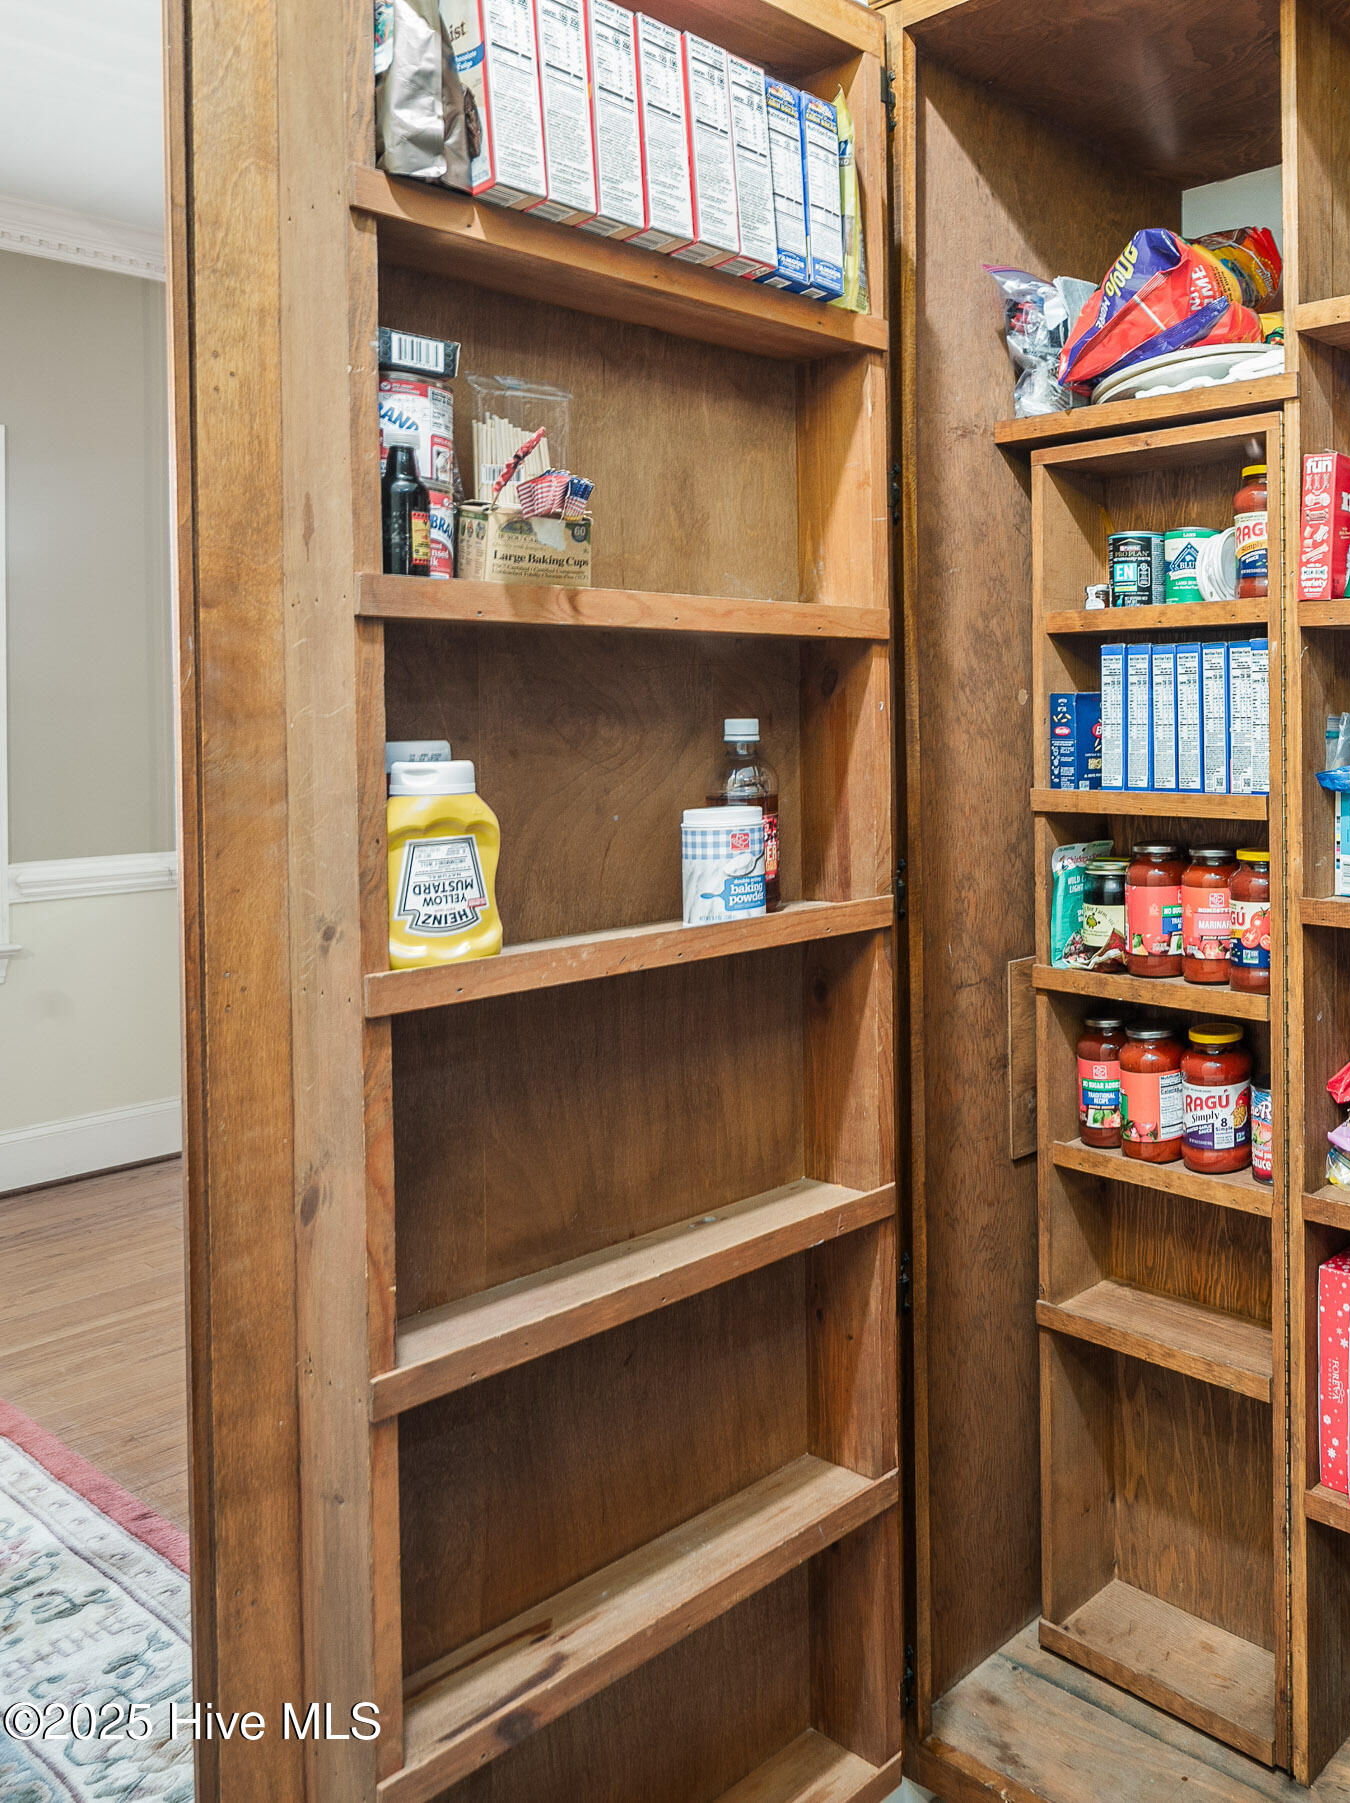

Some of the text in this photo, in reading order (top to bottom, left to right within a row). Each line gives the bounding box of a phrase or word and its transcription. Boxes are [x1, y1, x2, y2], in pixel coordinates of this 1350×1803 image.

[1306, 457, 1332, 474] fun
[1236, 522, 1267, 546] RAG
[493, 550, 526, 564] Large
[527, 552, 565, 567] Baking
[566, 555, 589, 569] Cups
[1180, 561, 1195, 569] BLU
[1116, 565, 1133, 580] EN
[413, 878, 474, 895] MUSTARD
[730, 882, 763, 895] baking
[423, 892, 467, 907] YELLOW
[729, 891, 764, 909] powder
[421, 908, 469, 926] HEINZ
[1231, 906, 1245, 926] GÚ
[1185, 1089, 1230, 1113] RAGÚ
[1192, 1111, 1220, 1123] Simply
[1221, 1118, 1227, 1127] 8
